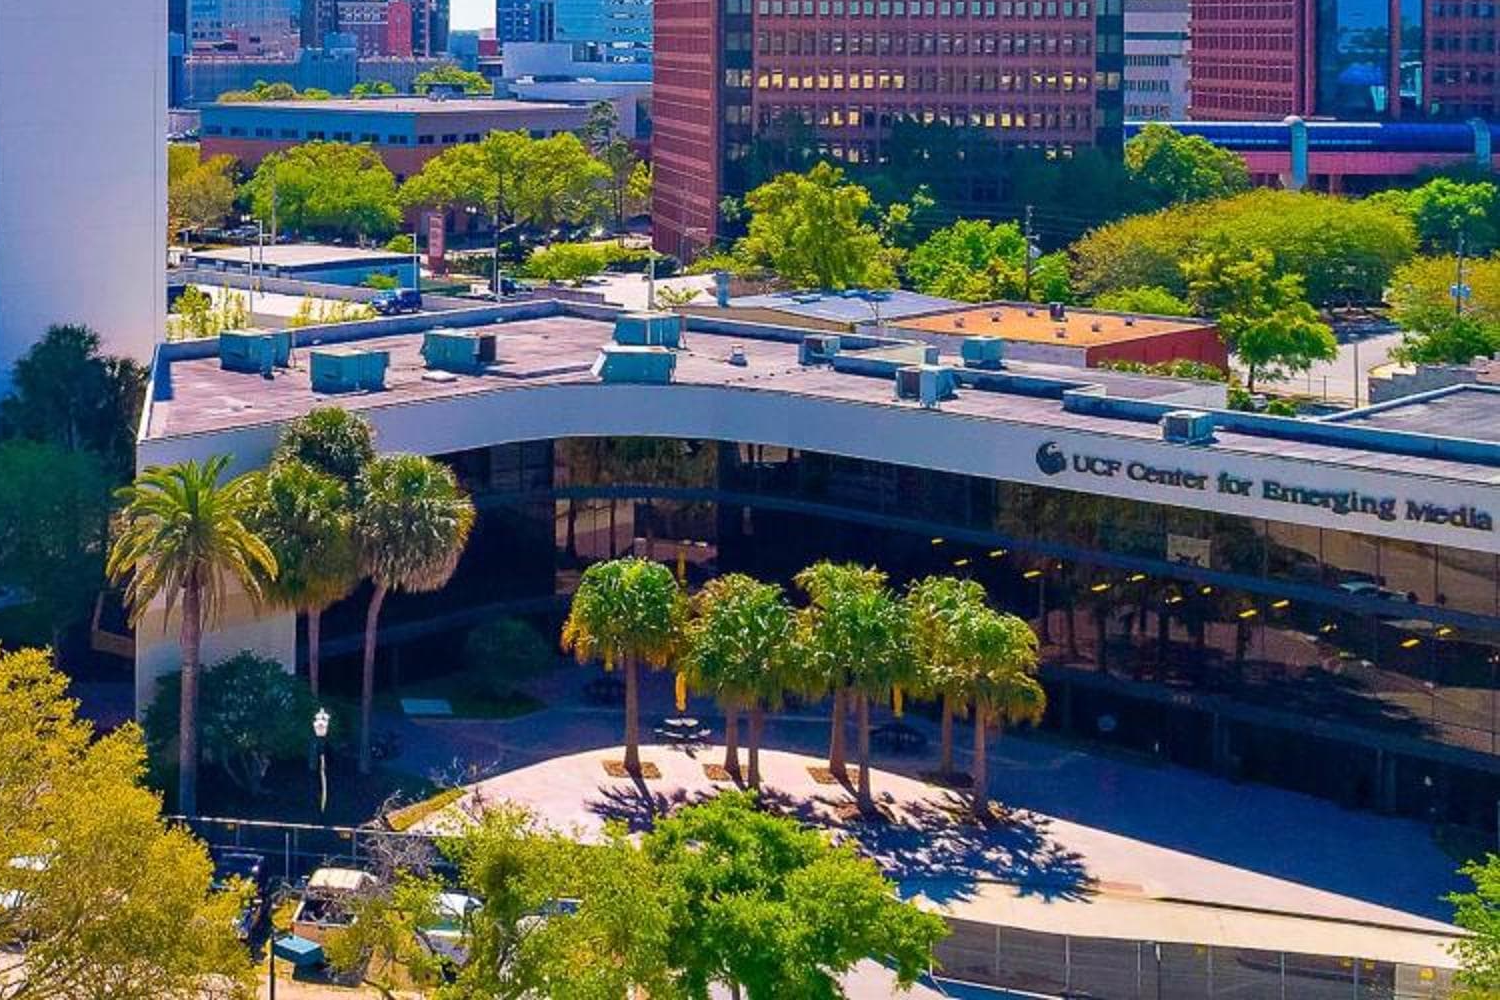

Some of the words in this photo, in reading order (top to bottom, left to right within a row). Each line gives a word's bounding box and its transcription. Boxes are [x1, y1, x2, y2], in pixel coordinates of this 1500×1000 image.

[1073, 455, 1120, 477] UCF
[1127, 462, 1208, 491] Center
[1217, 471, 1253, 497] for
[1262, 479, 1397, 521] Emerging
[1405, 500, 1492, 531] Media
